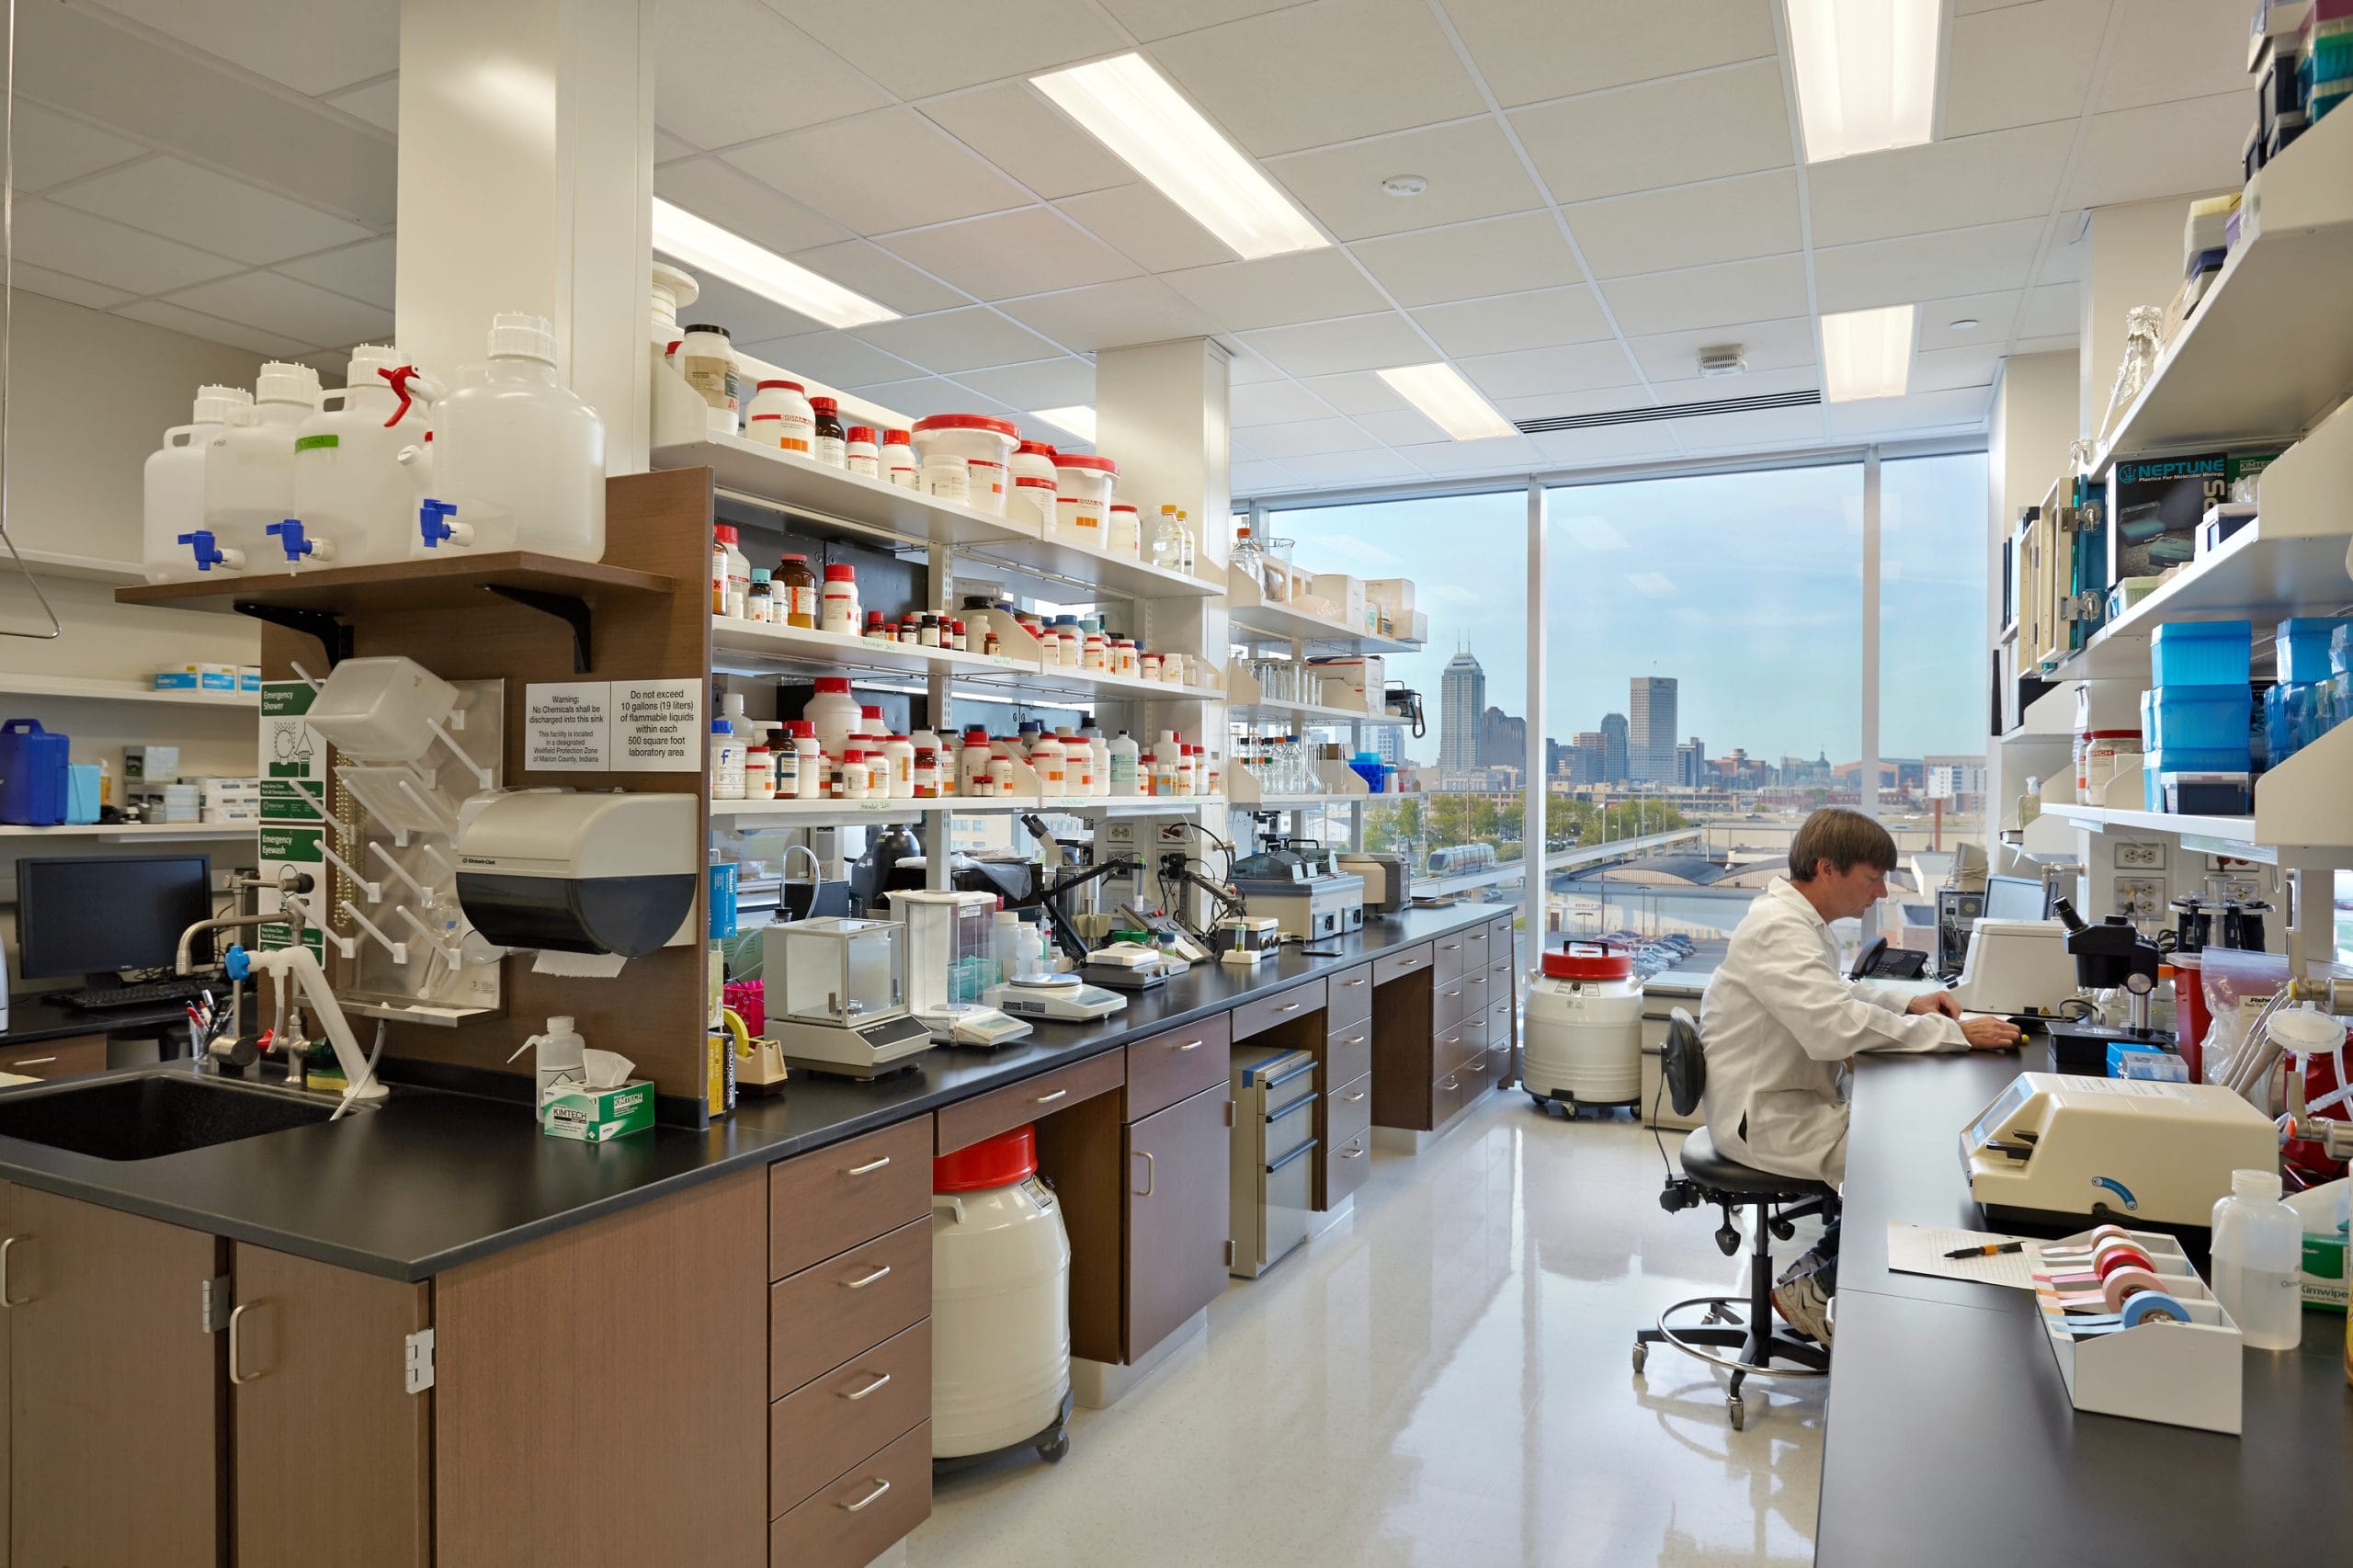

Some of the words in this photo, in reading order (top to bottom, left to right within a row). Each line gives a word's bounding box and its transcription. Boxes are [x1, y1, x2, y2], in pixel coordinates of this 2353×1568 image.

[2139, 460, 2224, 477] NEPTUNE
[264, 691, 293, 700] Emergency
[657, 690, 683, 699] exceed
[552, 696, 579, 704] Warning:
[263, 702, 283, 710] Shower
[621, 702, 631, 710] 10
[632, 701, 658, 712] gallons
[660, 701, 671, 710] (19
[673, 701, 693, 710] liters)
[620, 713, 629, 722] of
[630, 713, 667, 722] flammable
[669, 712, 694, 723] liquids
[642, 738, 668, 746] square
[629, 748, 665, 758] laboratory
[262, 835, 292, 846] Emergency
[262, 846, 286, 856] Eyewash
[614, 1093, 643, 1107] KIMTECH
[553, 1108, 587, 1120] KIMTECH
[2301, 1285, 2349, 1299] Kimwipe
